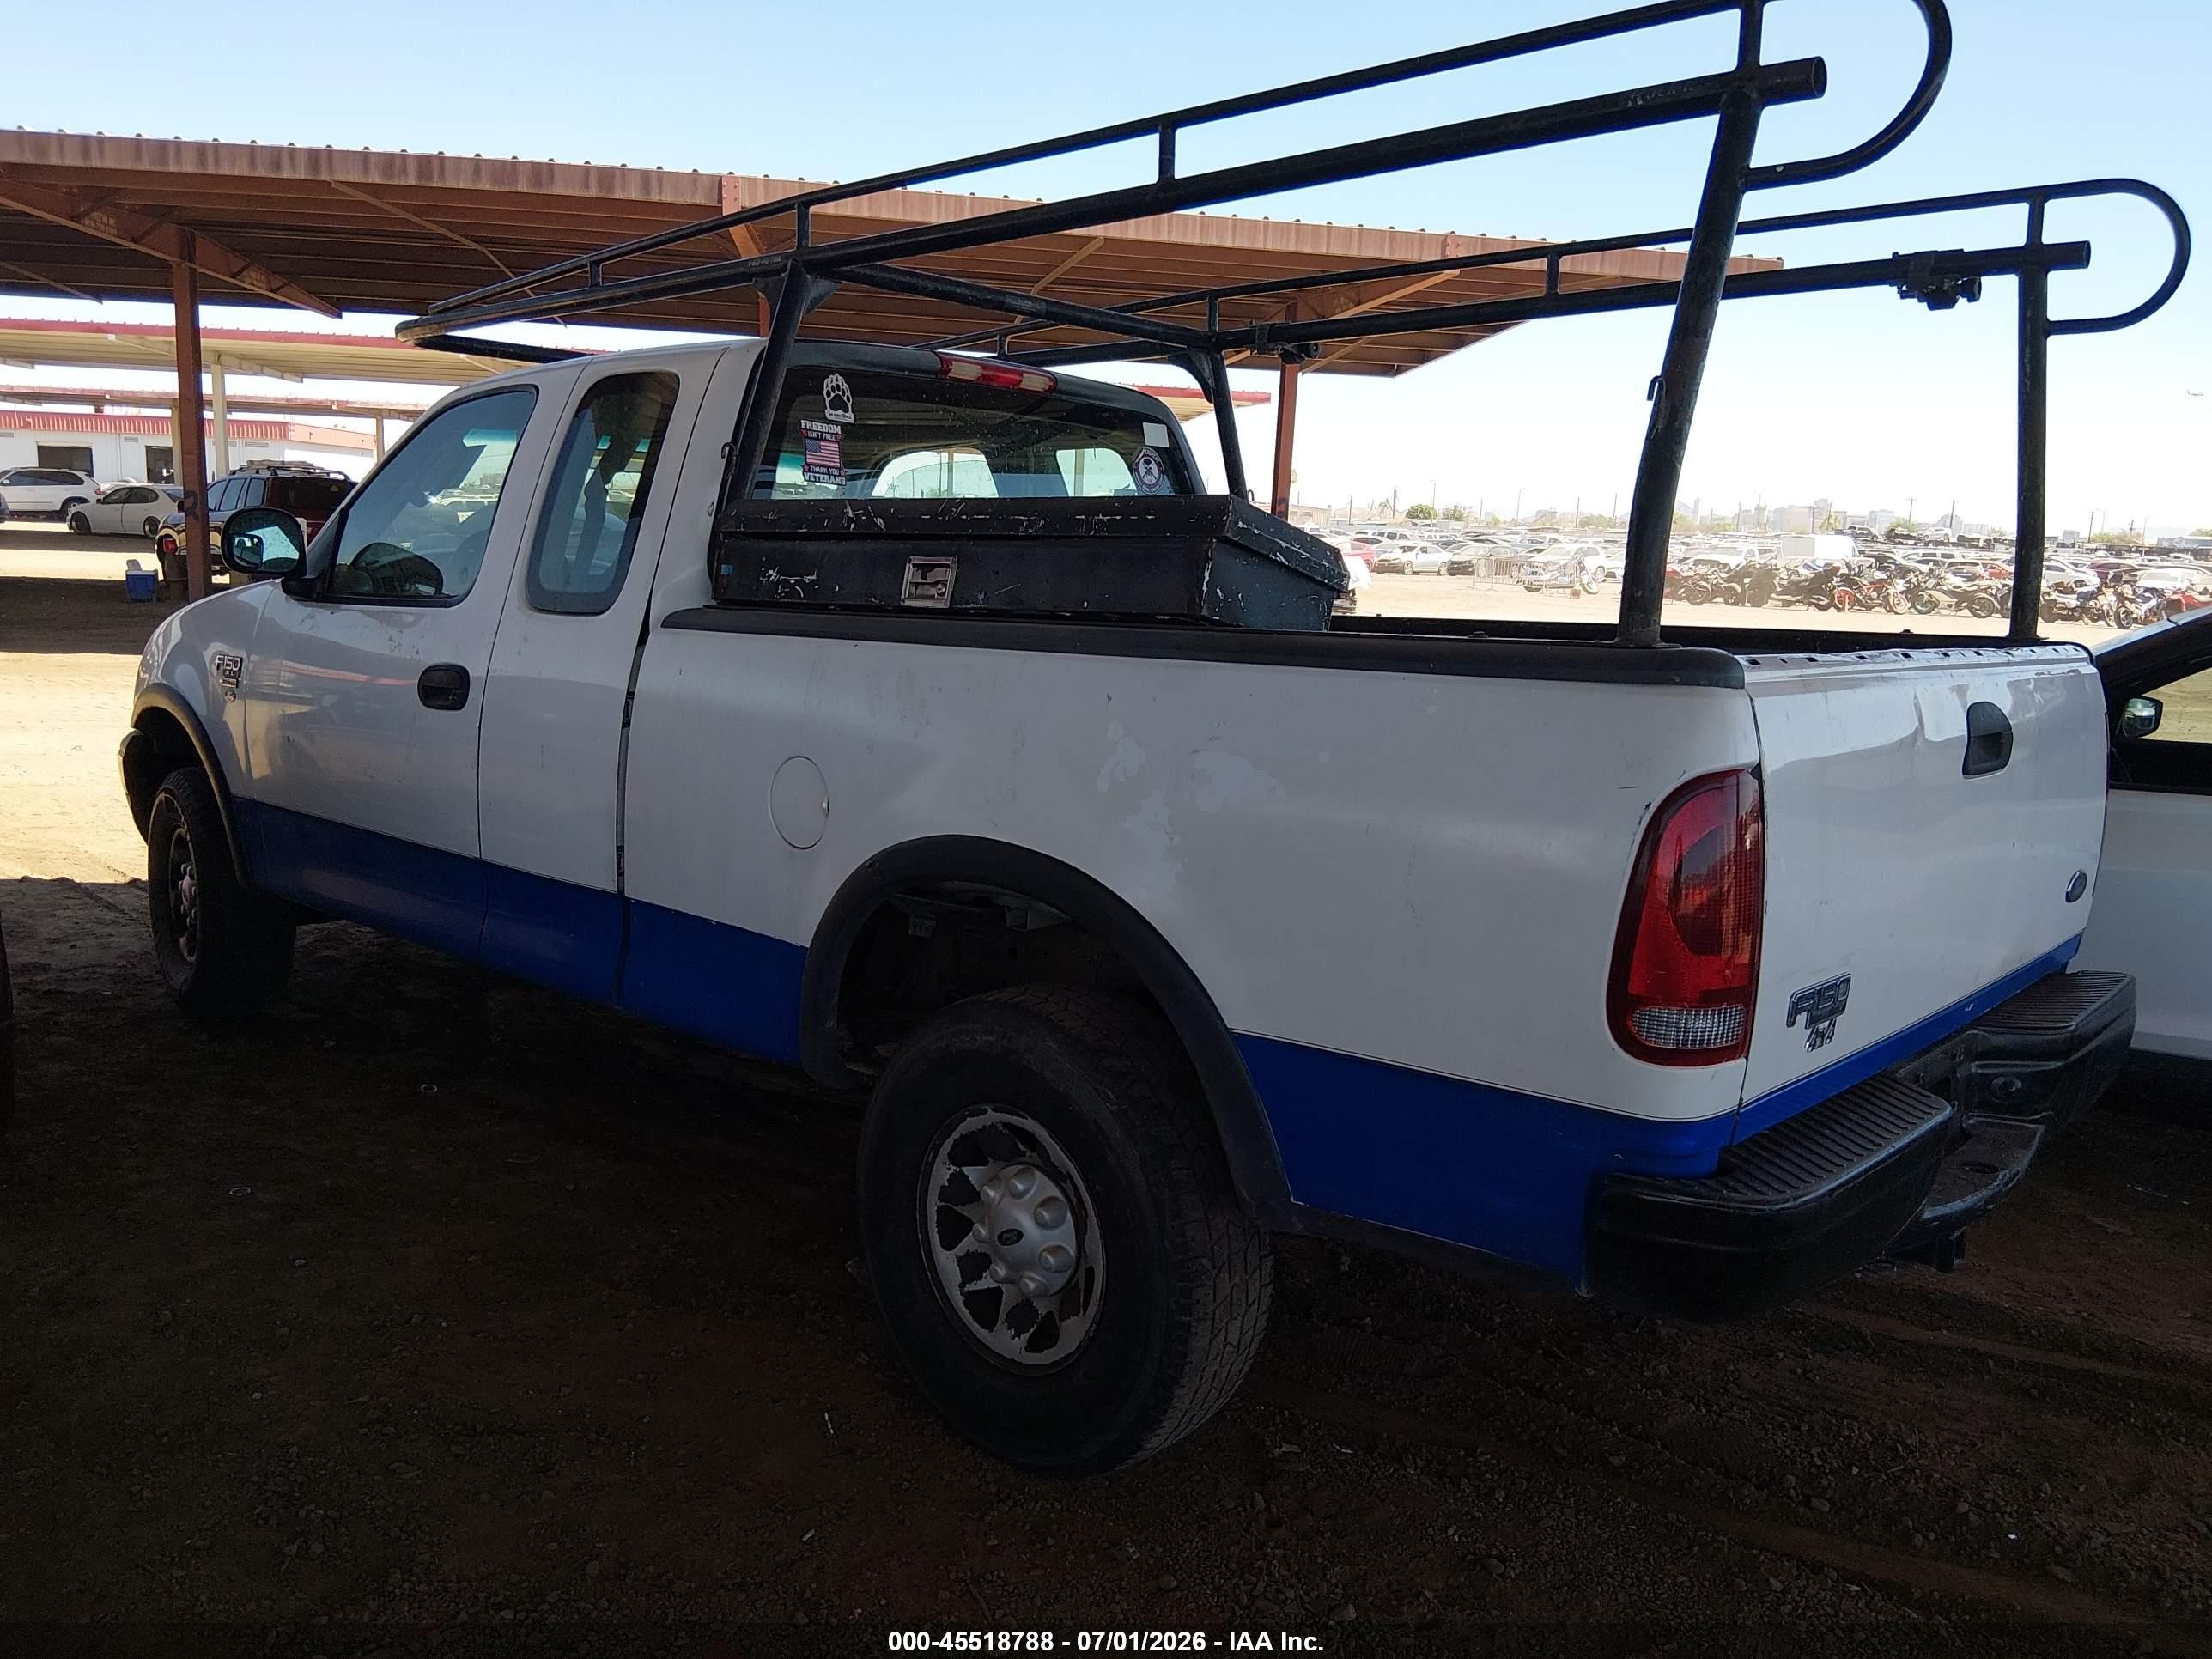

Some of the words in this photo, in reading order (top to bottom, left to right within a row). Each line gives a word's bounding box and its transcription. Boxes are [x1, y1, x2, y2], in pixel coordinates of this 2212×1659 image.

[800, 419, 842, 434] FREEDOM
[807, 430, 822, 440] ISN'T
[823, 432, 836, 441] FREE
[810, 465, 828, 474] THANK
[829, 466, 840, 476] YOU
[804, 472, 846, 485] VETERANS
[216, 654, 240, 672] F150
[1787, 971, 1851, 1029] F150
